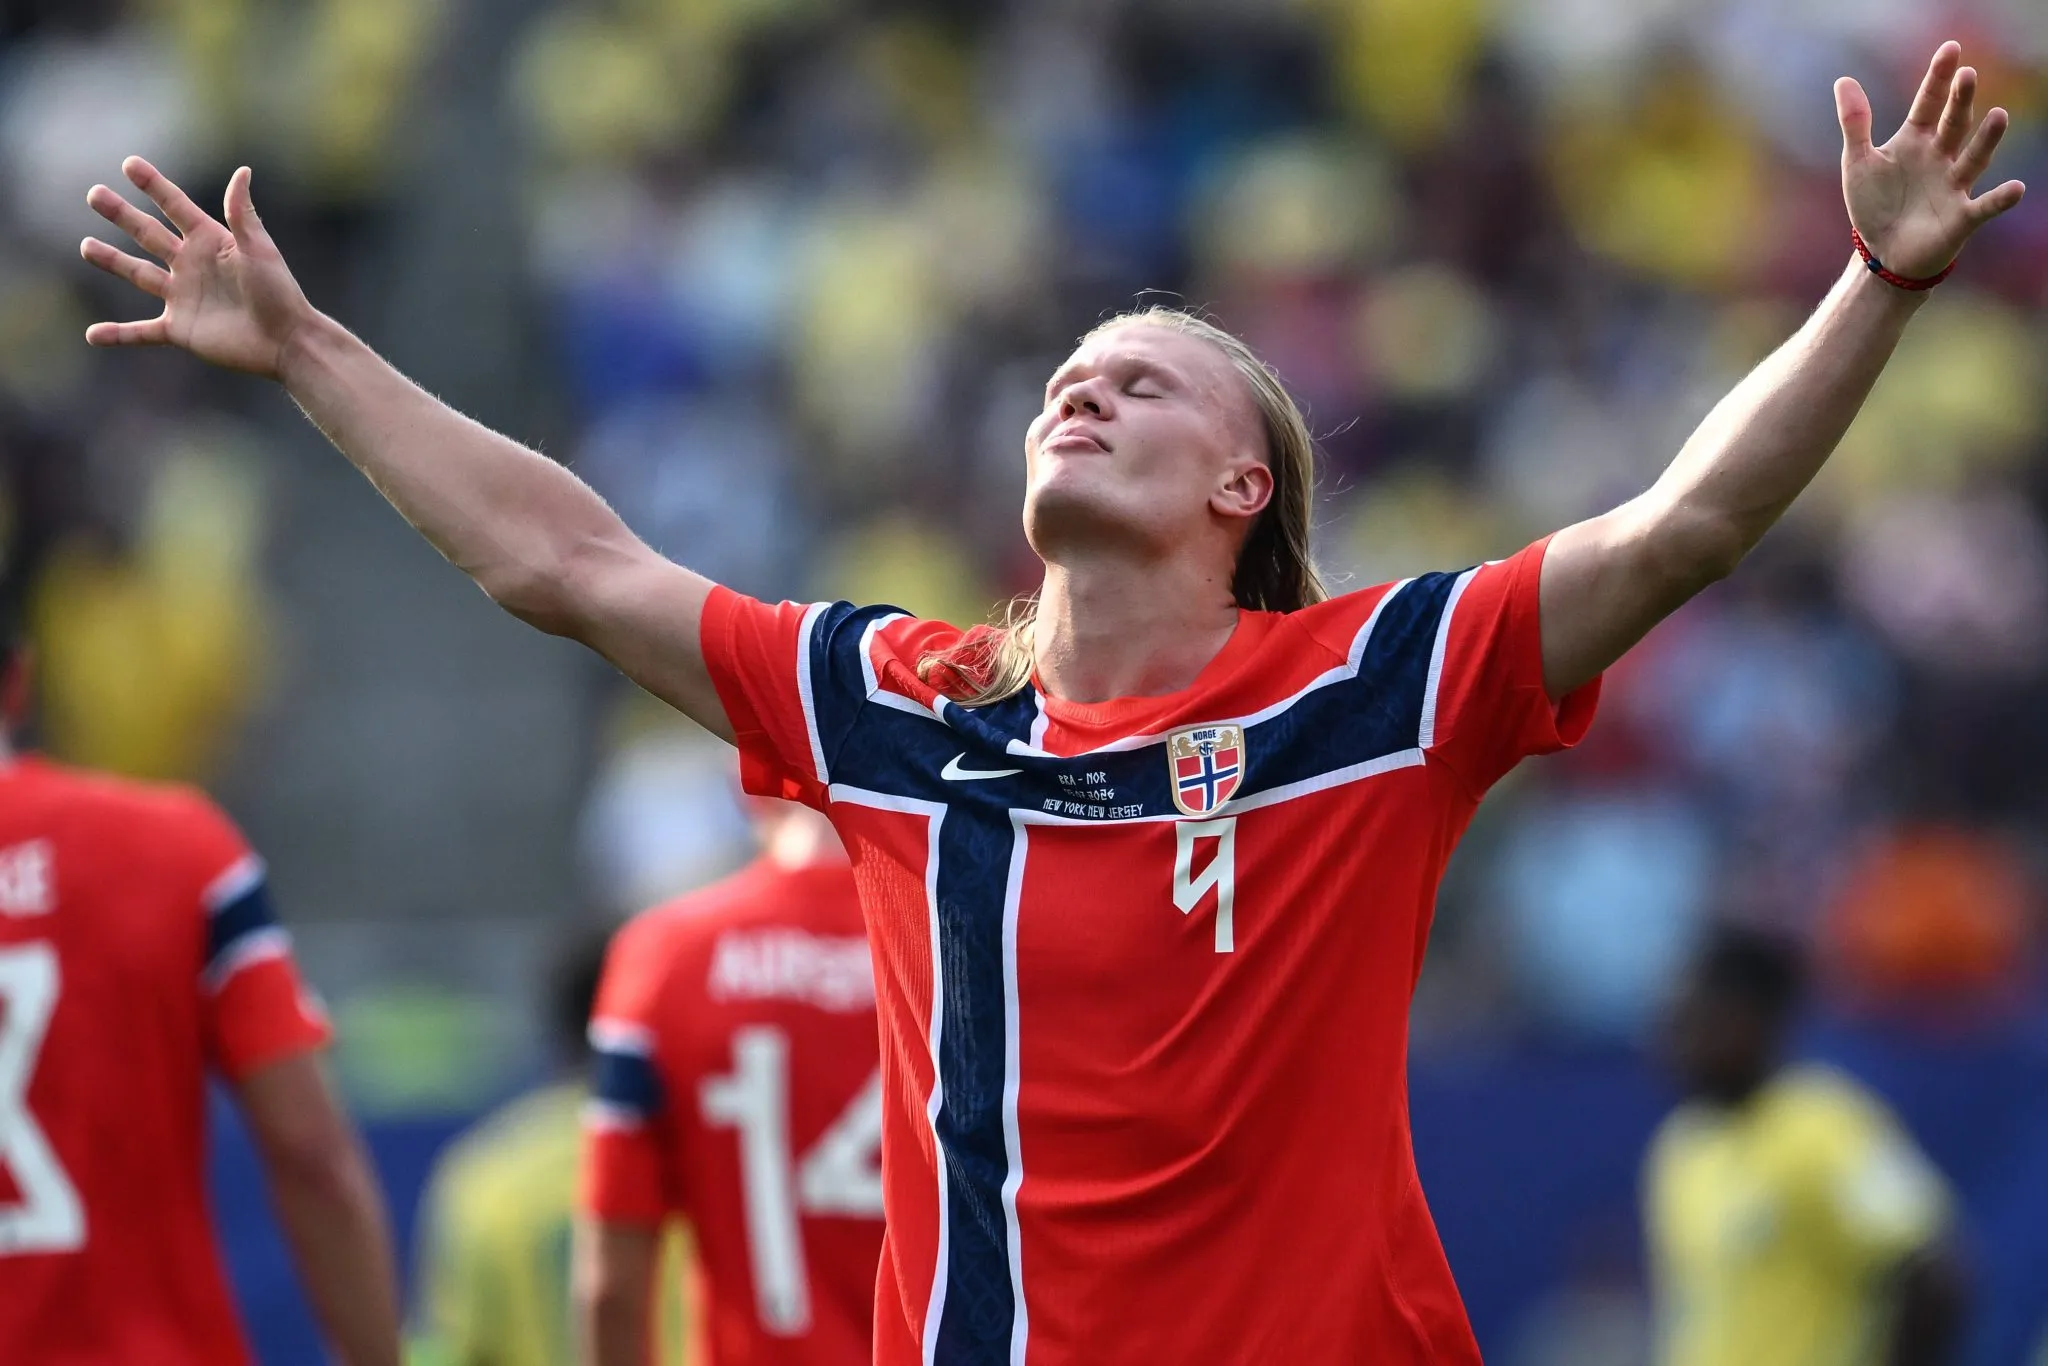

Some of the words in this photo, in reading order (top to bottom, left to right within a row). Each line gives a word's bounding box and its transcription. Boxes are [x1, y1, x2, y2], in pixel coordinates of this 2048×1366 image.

[1192, 729, 1217, 741] NORGE
[1058, 774, 1076, 786] BRA
[1086, 771, 1106, 785] NOR
[1042, 798, 1062, 811] NEW
[1063, 801, 1086, 816] YORK
[1087, 805, 1105, 818] NEW
[1107, 803, 1144, 819] JERSEY
[1173, 817, 1237, 953] 9
